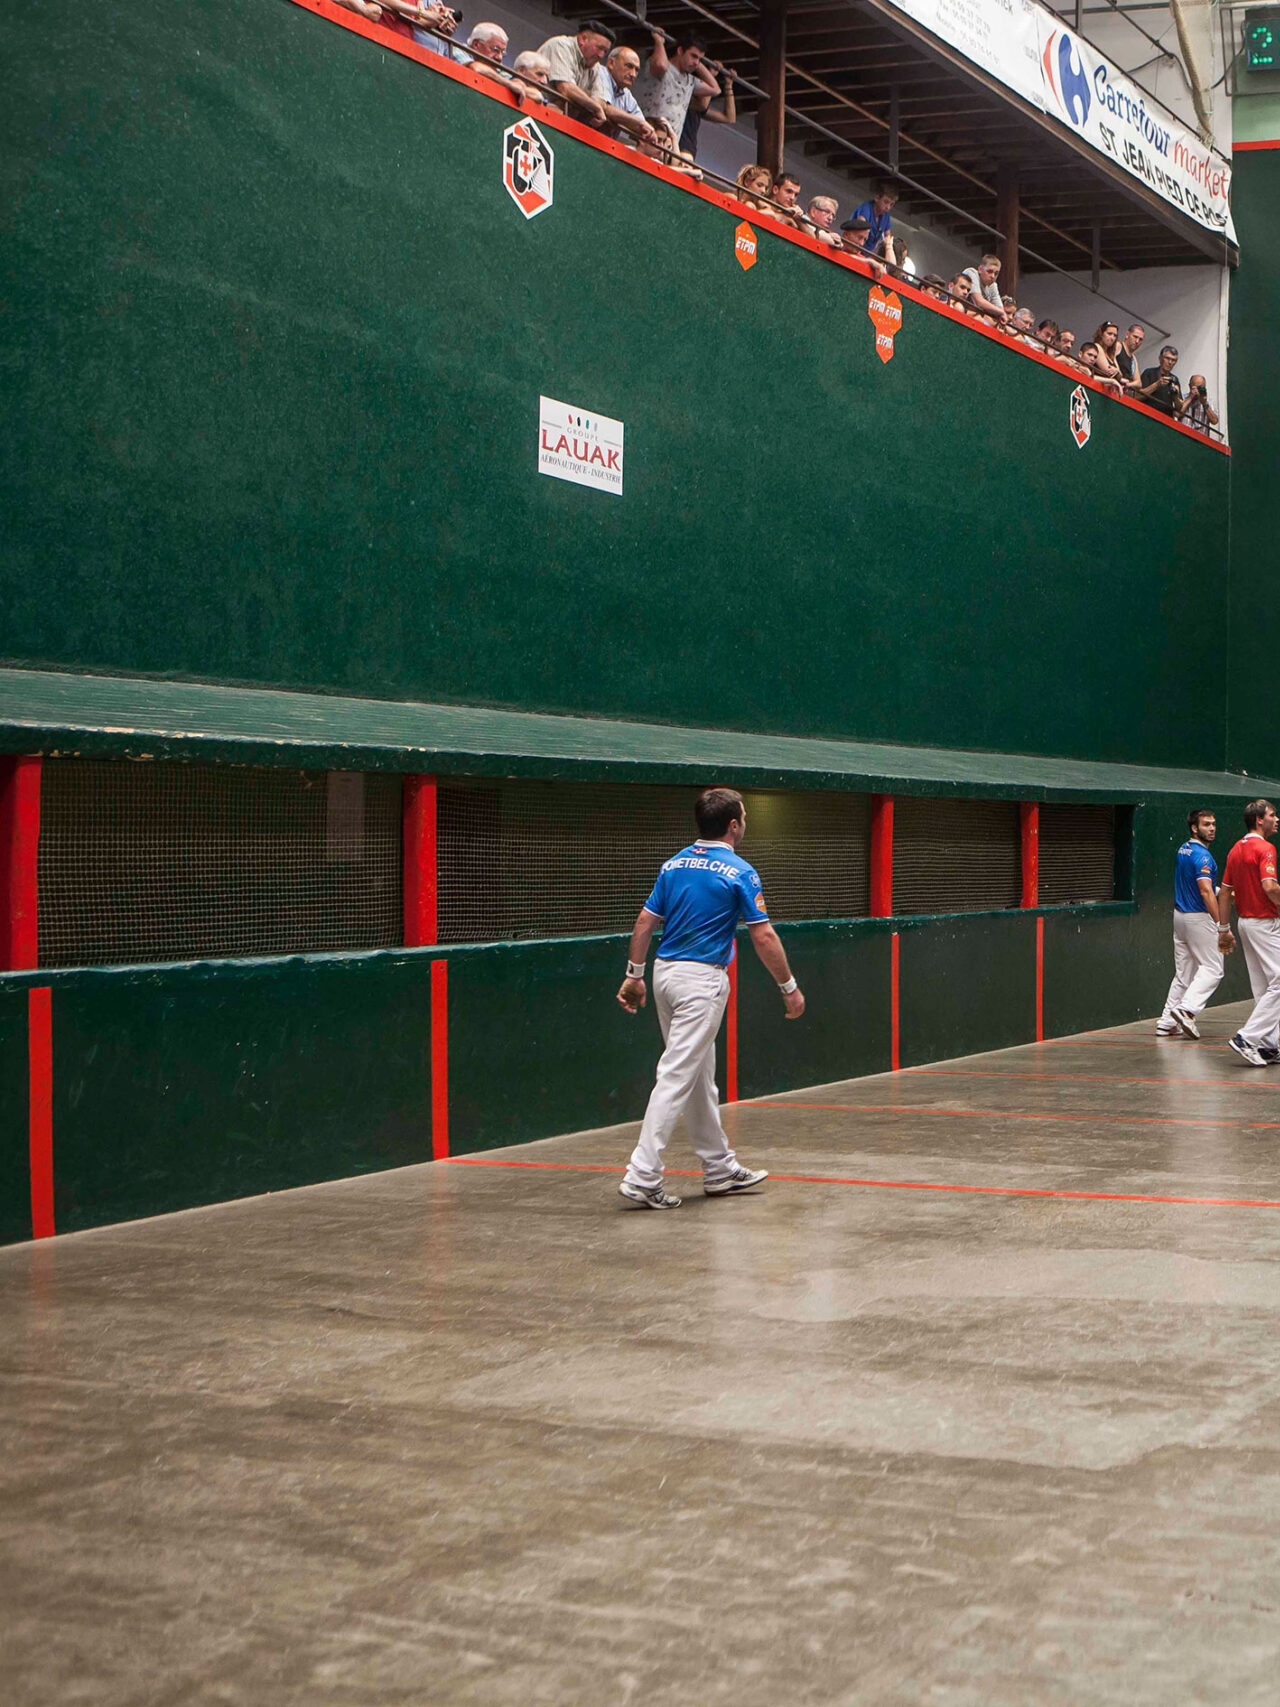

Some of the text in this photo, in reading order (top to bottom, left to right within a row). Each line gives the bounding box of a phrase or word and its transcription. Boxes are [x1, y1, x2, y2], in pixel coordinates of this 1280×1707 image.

[1093, 64, 1229, 199] Carrefour market
[1099, 122, 1119, 156] ST
[1122, 139, 1156, 185] JEAN
[1155, 166, 1184, 206] PIED
[541, 428, 621, 472] LAUAK
